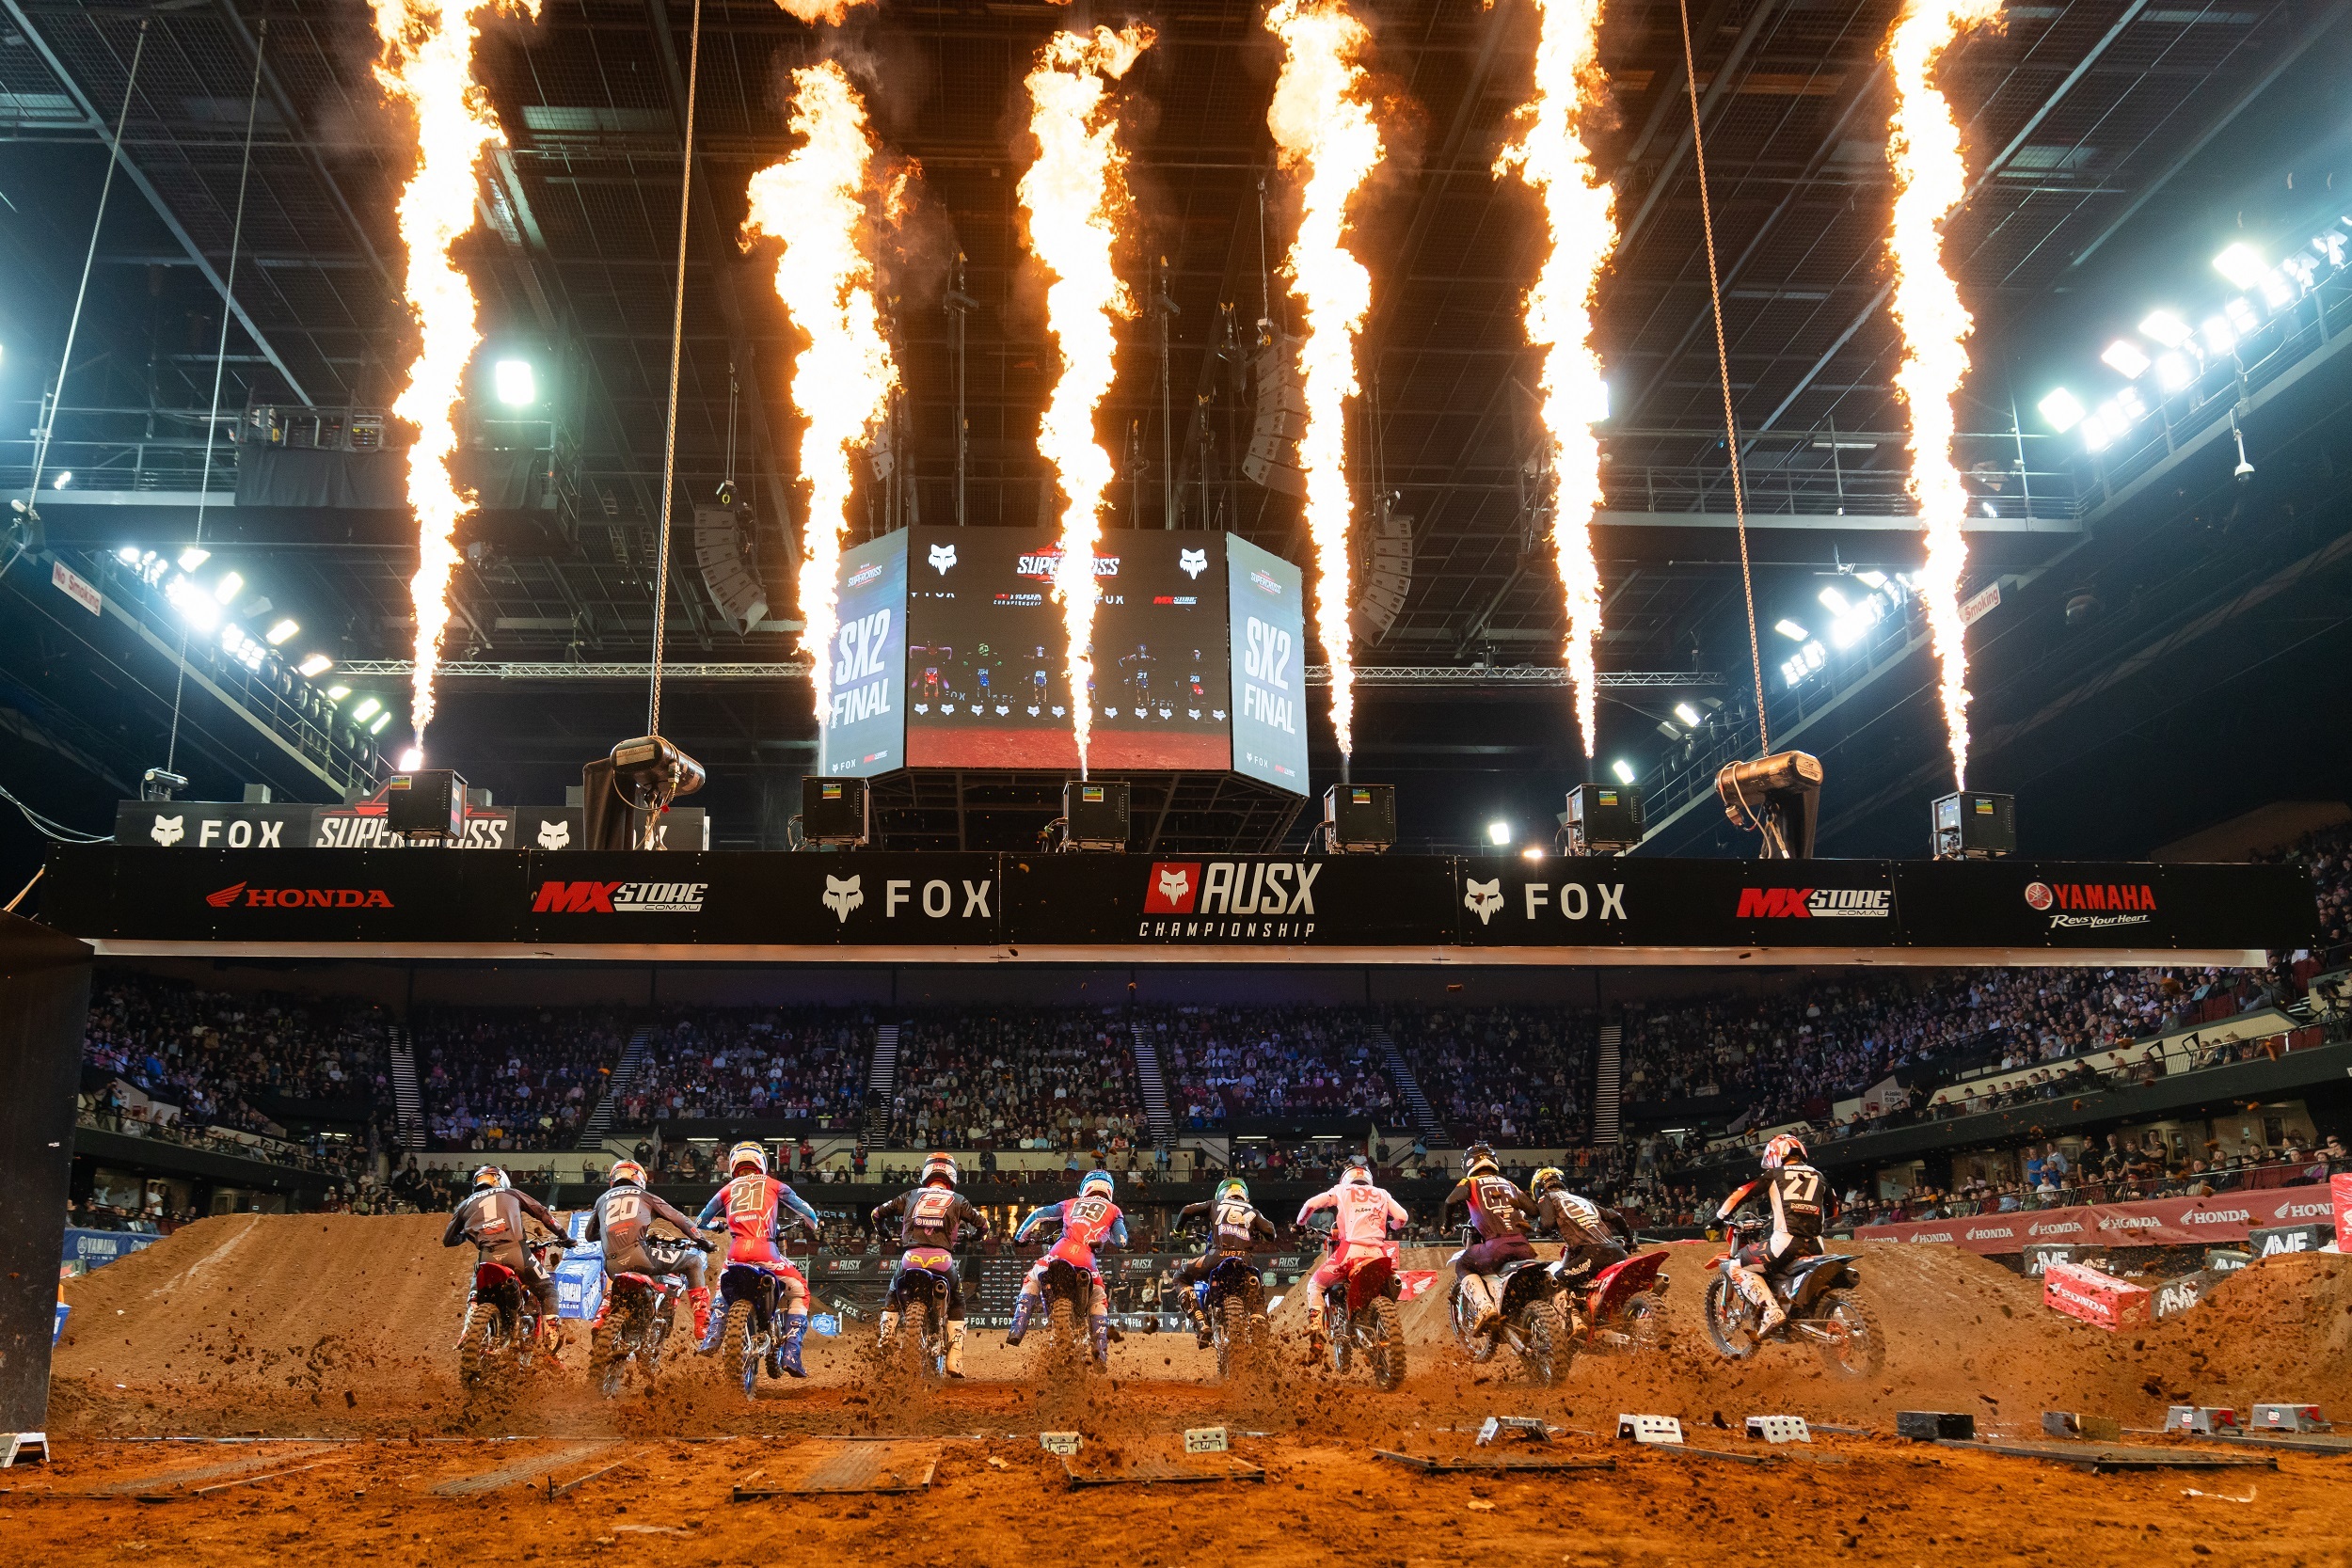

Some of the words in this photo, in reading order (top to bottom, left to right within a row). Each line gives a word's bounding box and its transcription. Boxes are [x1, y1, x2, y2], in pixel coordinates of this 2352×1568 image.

[55, 566, 66, 585] No
[69, 575, 101, 612] Smoking
[1965, 588, 1999, 621] Smoking
[835, 609, 891, 686] SX2
[1245, 616, 1292, 691] SX2
[831, 677, 891, 730] FINAL
[1243, 683, 1295, 735] FINAL
[840, 758, 856, 771] FOX
[1254, 755, 1268, 768] FOX
[199, 820, 284, 848] FOX
[245, 889, 395, 908] HONDA
[886, 879, 992, 918] FOX
[1200, 863, 1323, 915] AUSX
[2053, 884, 2157, 911] YAMAHA
[1524, 882, 1628, 920] FOX
[1139, 922, 1315, 938] CHAMPIONSHIP
[605, 1188, 642, 1200] TODD
[1346, 1187, 1382, 1203] 199
[1783, 1170, 1819, 1201] 27
[478, 1195, 498, 1223] 1
[728, 1180, 767, 1216] 21
[911, 1192, 955, 1219] 2
[605, 1196, 640, 1227] 20
[1070, 1200, 1107, 1223] 69
[1215, 1204, 1256, 1228] 754
[2194, 1209, 2250, 1224] HONDA
[2290, 1203, 2335, 1217] HON
[922, 1218, 944, 1227] YAMAHA
[1226, 1226, 1249, 1239] YAMAHA
[1976, 1227, 2014, 1240] HONDA
[2039, 1222, 2084, 1235] HONDA
[2110, 1216, 2162, 1229] HONDA
[1918, 1232, 1954, 1243] HONDA
[838, 1260, 862, 1270] AUSX
[1131, 1259, 1153, 1269] AUSX
[1279, 1258, 1300, 1268] AUSX
[2060, 1288, 2110, 1316] HONDA
[970, 1317, 986, 1325] FOX
